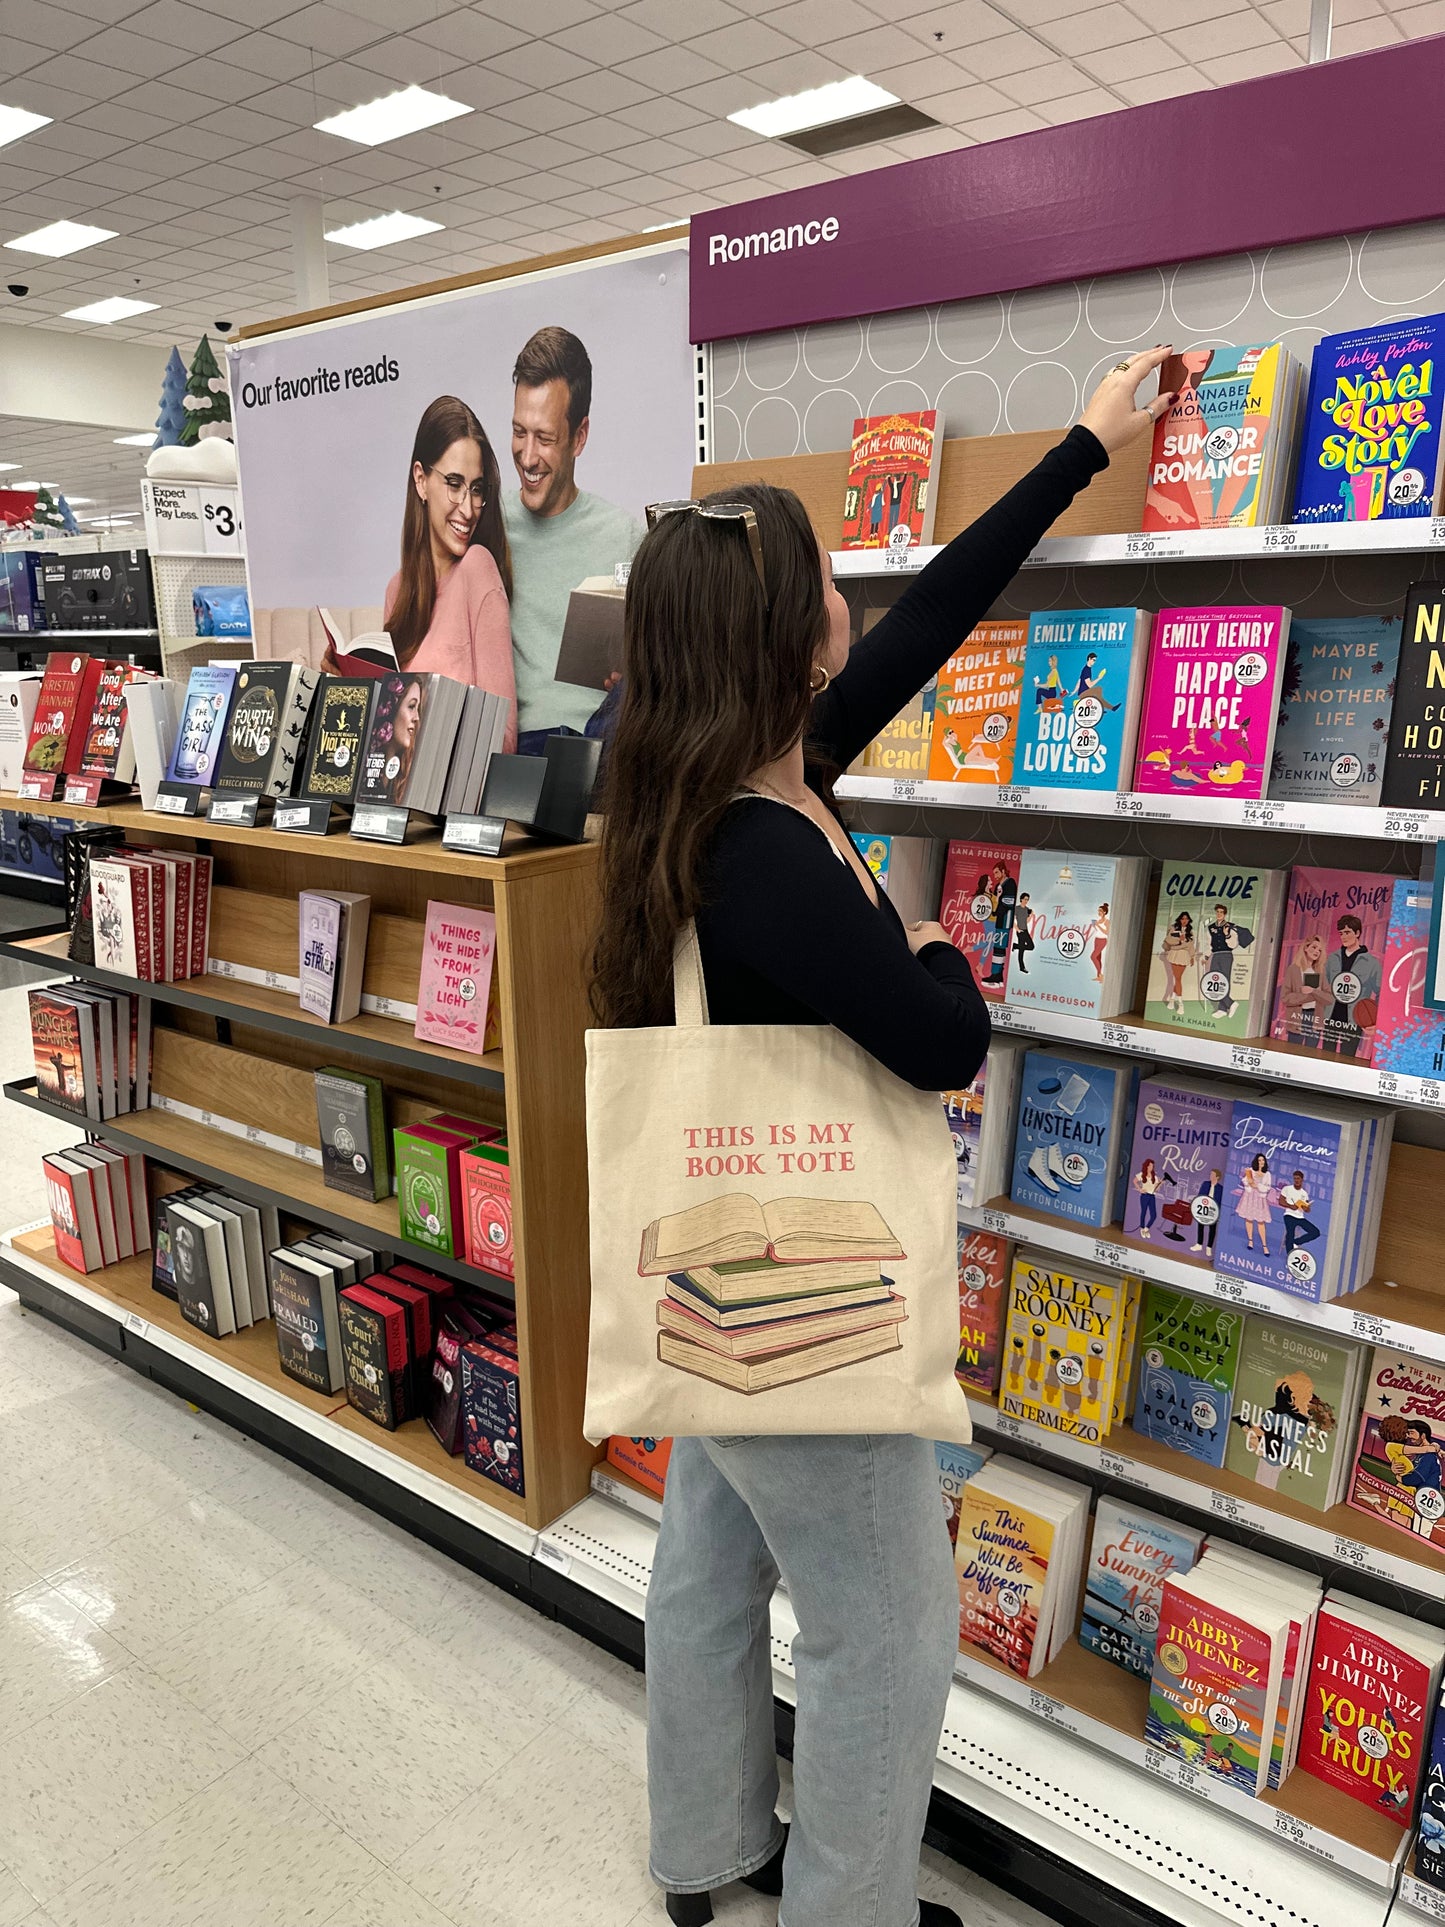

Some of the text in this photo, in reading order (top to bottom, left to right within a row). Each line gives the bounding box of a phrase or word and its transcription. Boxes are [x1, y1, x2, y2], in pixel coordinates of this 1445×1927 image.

[709, 217, 839, 266] Romance
[1335, 338, 1433, 370] Ashley Poston
[242, 355, 400, 408] Our favorite reads
[1321, 359, 1433, 415] Novel
[1184, 384, 1251, 403] ANNABEL
[1171, 397, 1262, 418] MONAGHAN
[1333, 399, 1426, 442] Love
[853, 444, 869, 463] KISS
[870, 437, 881, 453] ME
[889, 435, 929, 457] CHRISTMAS
[1319, 421, 1432, 475] Story
[1153, 452, 1262, 485] ROMANCE
[153, 487, 186, 499] Expect
[154, 498, 181, 508] More.
[155, 509, 199, 520] Pay Less.
[1127, 541, 1154, 551] 15.20
[1264, 535, 1295, 545] 15.20
[885, 557, 908, 565] 14.39
[1034, 622, 1127, 643] EMILY HENRY
[946, 644, 1027, 674] PEOPLE WE
[44, 680, 76, 691] KRISTIN
[100, 673, 120, 687] Long
[954, 672, 1015, 694] MEET ON
[40, 695, 74, 707] HANNAH
[100, 692, 123, 706] After
[946, 689, 1020, 715] VACATION
[93, 713, 120, 726] We Are
[235, 709, 275, 725] FOURTH
[1172, 697, 1243, 730] PLACE
[184, 719, 213, 734] GLASS
[98, 734, 119, 747] Ge
[182, 738, 204, 753] GIRL
[320, 728, 358, 755] VIOLENT
[367, 769, 380, 778] WITH
[371, 758, 385, 769] ENDS
[219, 779, 264, 789] REBECCA YARROS
[367, 778, 375, 788] US
[893, 787, 915, 795] 12.80
[998, 794, 1022, 802] 13.60
[1116, 801, 1143, 810] 15.20
[1244, 809, 1273, 820] 14.40
[1384, 821, 1419, 832] 20.99
[91, 869, 125, 883] BLOODGUARD
[1166, 874, 1258, 899] COLLIDE
[1293, 885, 1391, 918] Night Shift
[441, 924, 481, 942] THINGS
[312, 940, 324, 954] THE
[437, 940, 480, 960] WE HIDE
[304, 951, 334, 977] STRIR
[442, 958, 471, 975] FROM
[437, 991, 468, 1009] LIGHT
[1011, 988, 1095, 1008] LANA FERGUSON
[31, 1012, 73, 1033] HUNGER
[1171, 1015, 1216, 1029] BAL KHABRA
[1291, 1012, 1321, 1024] ANNIE
[1323, 1017, 1357, 1032] CROWN
[37, 1027, 74, 1050] GAMES
[432, 1026, 466, 1041] LUCY SCORE
[1103, 1031, 1129, 1042] 15.20
[1232, 1054, 1261, 1067] 14.39
[1158, 1089, 1222, 1110] SARAH ADAMS
[1021, 1107, 1106, 1147] UNSTEADY
[1179, 1112, 1195, 1126] The
[684, 1123, 855, 1148] THIS IS MY
[1142, 1125, 1230, 1148] OFF-LIMITS
[1234, 1116, 1334, 1159] Daydream
[685, 1151, 856, 1177] BOOK TOTE
[1160, 1144, 1207, 1173] Rule
[1016, 1187, 1097, 1221] PEYTON CORINNE
[983, 1216, 1006, 1228] 15.19
[1094, 1248, 1120, 1261] 14.40
[280, 1270, 297, 1286] JOHN
[1215, 1273, 1245, 1285] DAYDREAM
[272, 1279, 310, 1308] GRISHAM
[1027, 1269, 1101, 1309] SALLY
[1214, 1281, 1242, 1297] 18.99
[273, 1299, 318, 1334] FRAMED
[1013, 1287, 1112, 1337] ROONEY
[1353, 1311, 1382, 1322] MORBIDLY
[347, 1320, 374, 1345] Court
[1154, 1311, 1232, 1348] NORMAL
[352, 1341, 369, 1358] of the
[1156, 1331, 1224, 1366] PEOPLE
[344, 1344, 384, 1381] Vamre
[482, 1395, 498, 1410] if he
[474, 1403, 507, 1426] had been
[1003, 1396, 1099, 1441] INTERMEZZO
[478, 1415, 505, 1436] with me
[1240, 1400, 1328, 1454] BUSINESS
[1245, 1429, 1314, 1478] CASUAL
[614, 1446, 665, 1484] Bonnie Garmus
[995, 1509, 1025, 1534] This
[977, 1544, 1024, 1573] Will Be
[1118, 1530, 1179, 1575] Every
[1186, 1616, 1244, 1653] ABBY
[1166, 1624, 1260, 1683] JIMENEZ
[1179, 1677, 1237, 1707] JUST FOR
[1275, 1819, 1304, 1839] 13.59
[1276, 1809, 1314, 1830] YOURS TRULY
